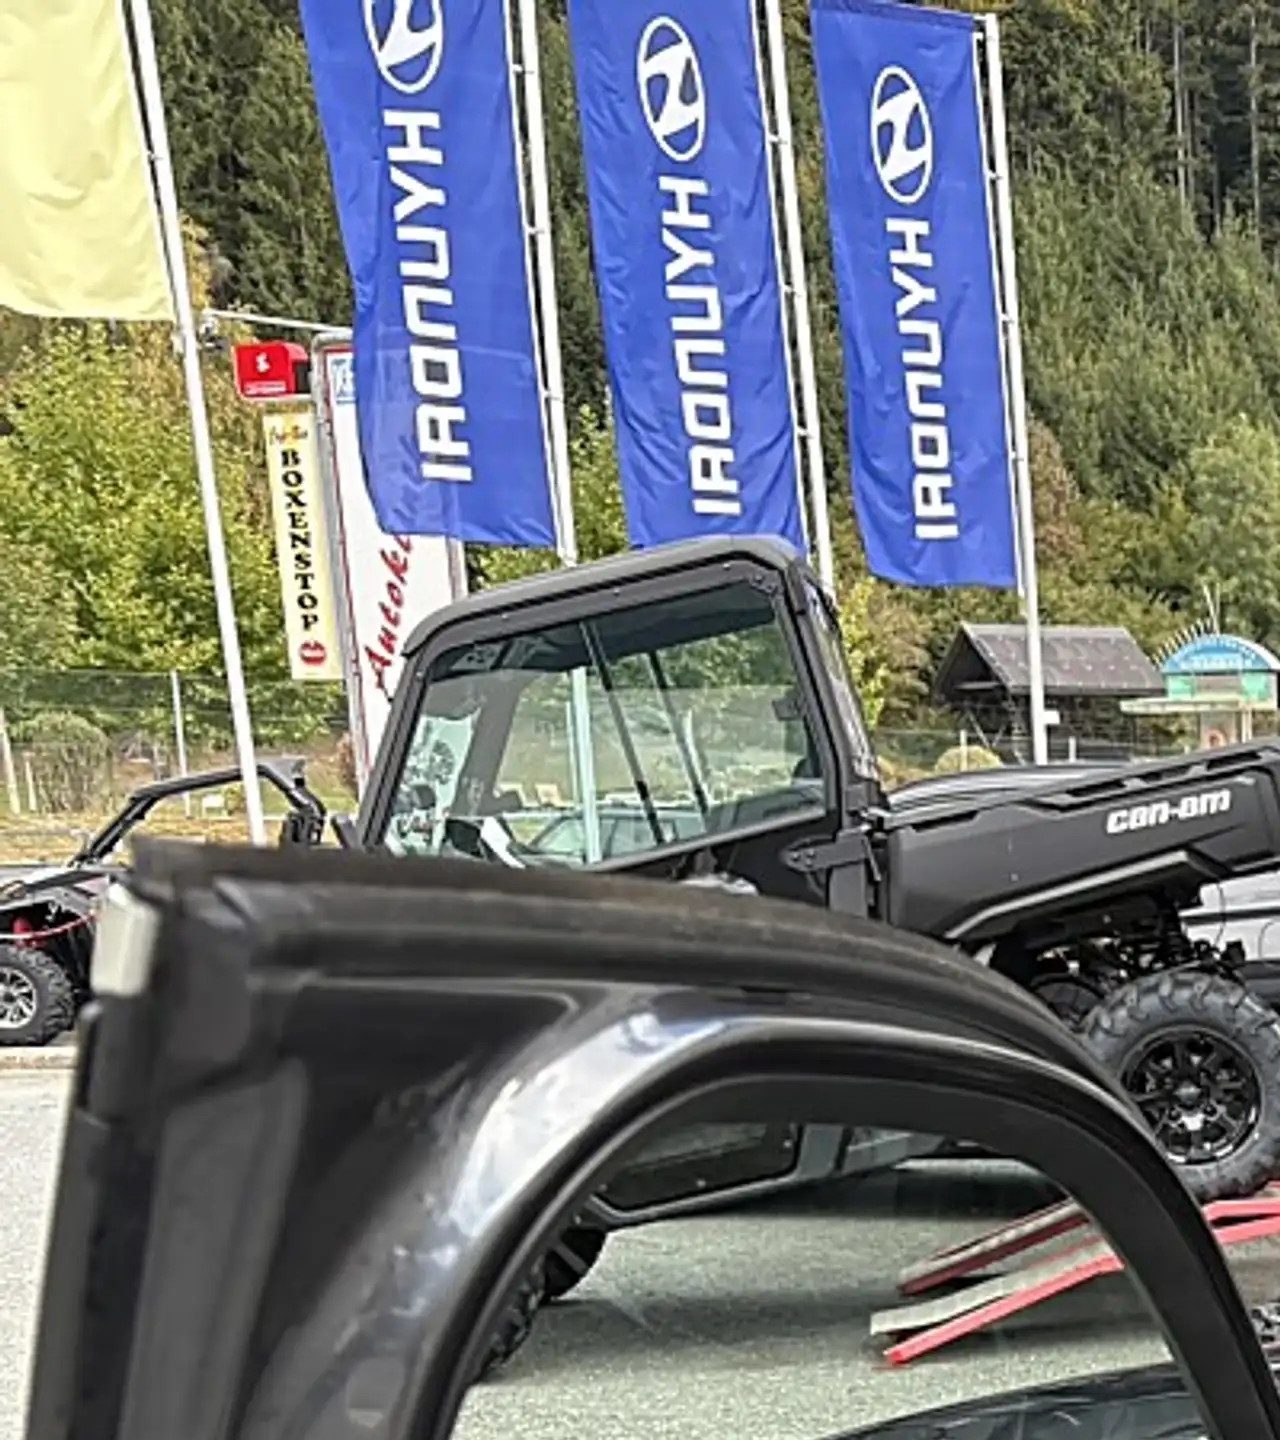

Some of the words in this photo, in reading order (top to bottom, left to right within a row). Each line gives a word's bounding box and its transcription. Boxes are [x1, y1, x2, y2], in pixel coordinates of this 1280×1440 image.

[383, 109, 473, 483] HYUNDAI
[657, 174, 742, 517] HYUNDAI
[885, 216, 959, 541] HYUNDAI
[281, 448, 319, 632] BOXENSTOP
